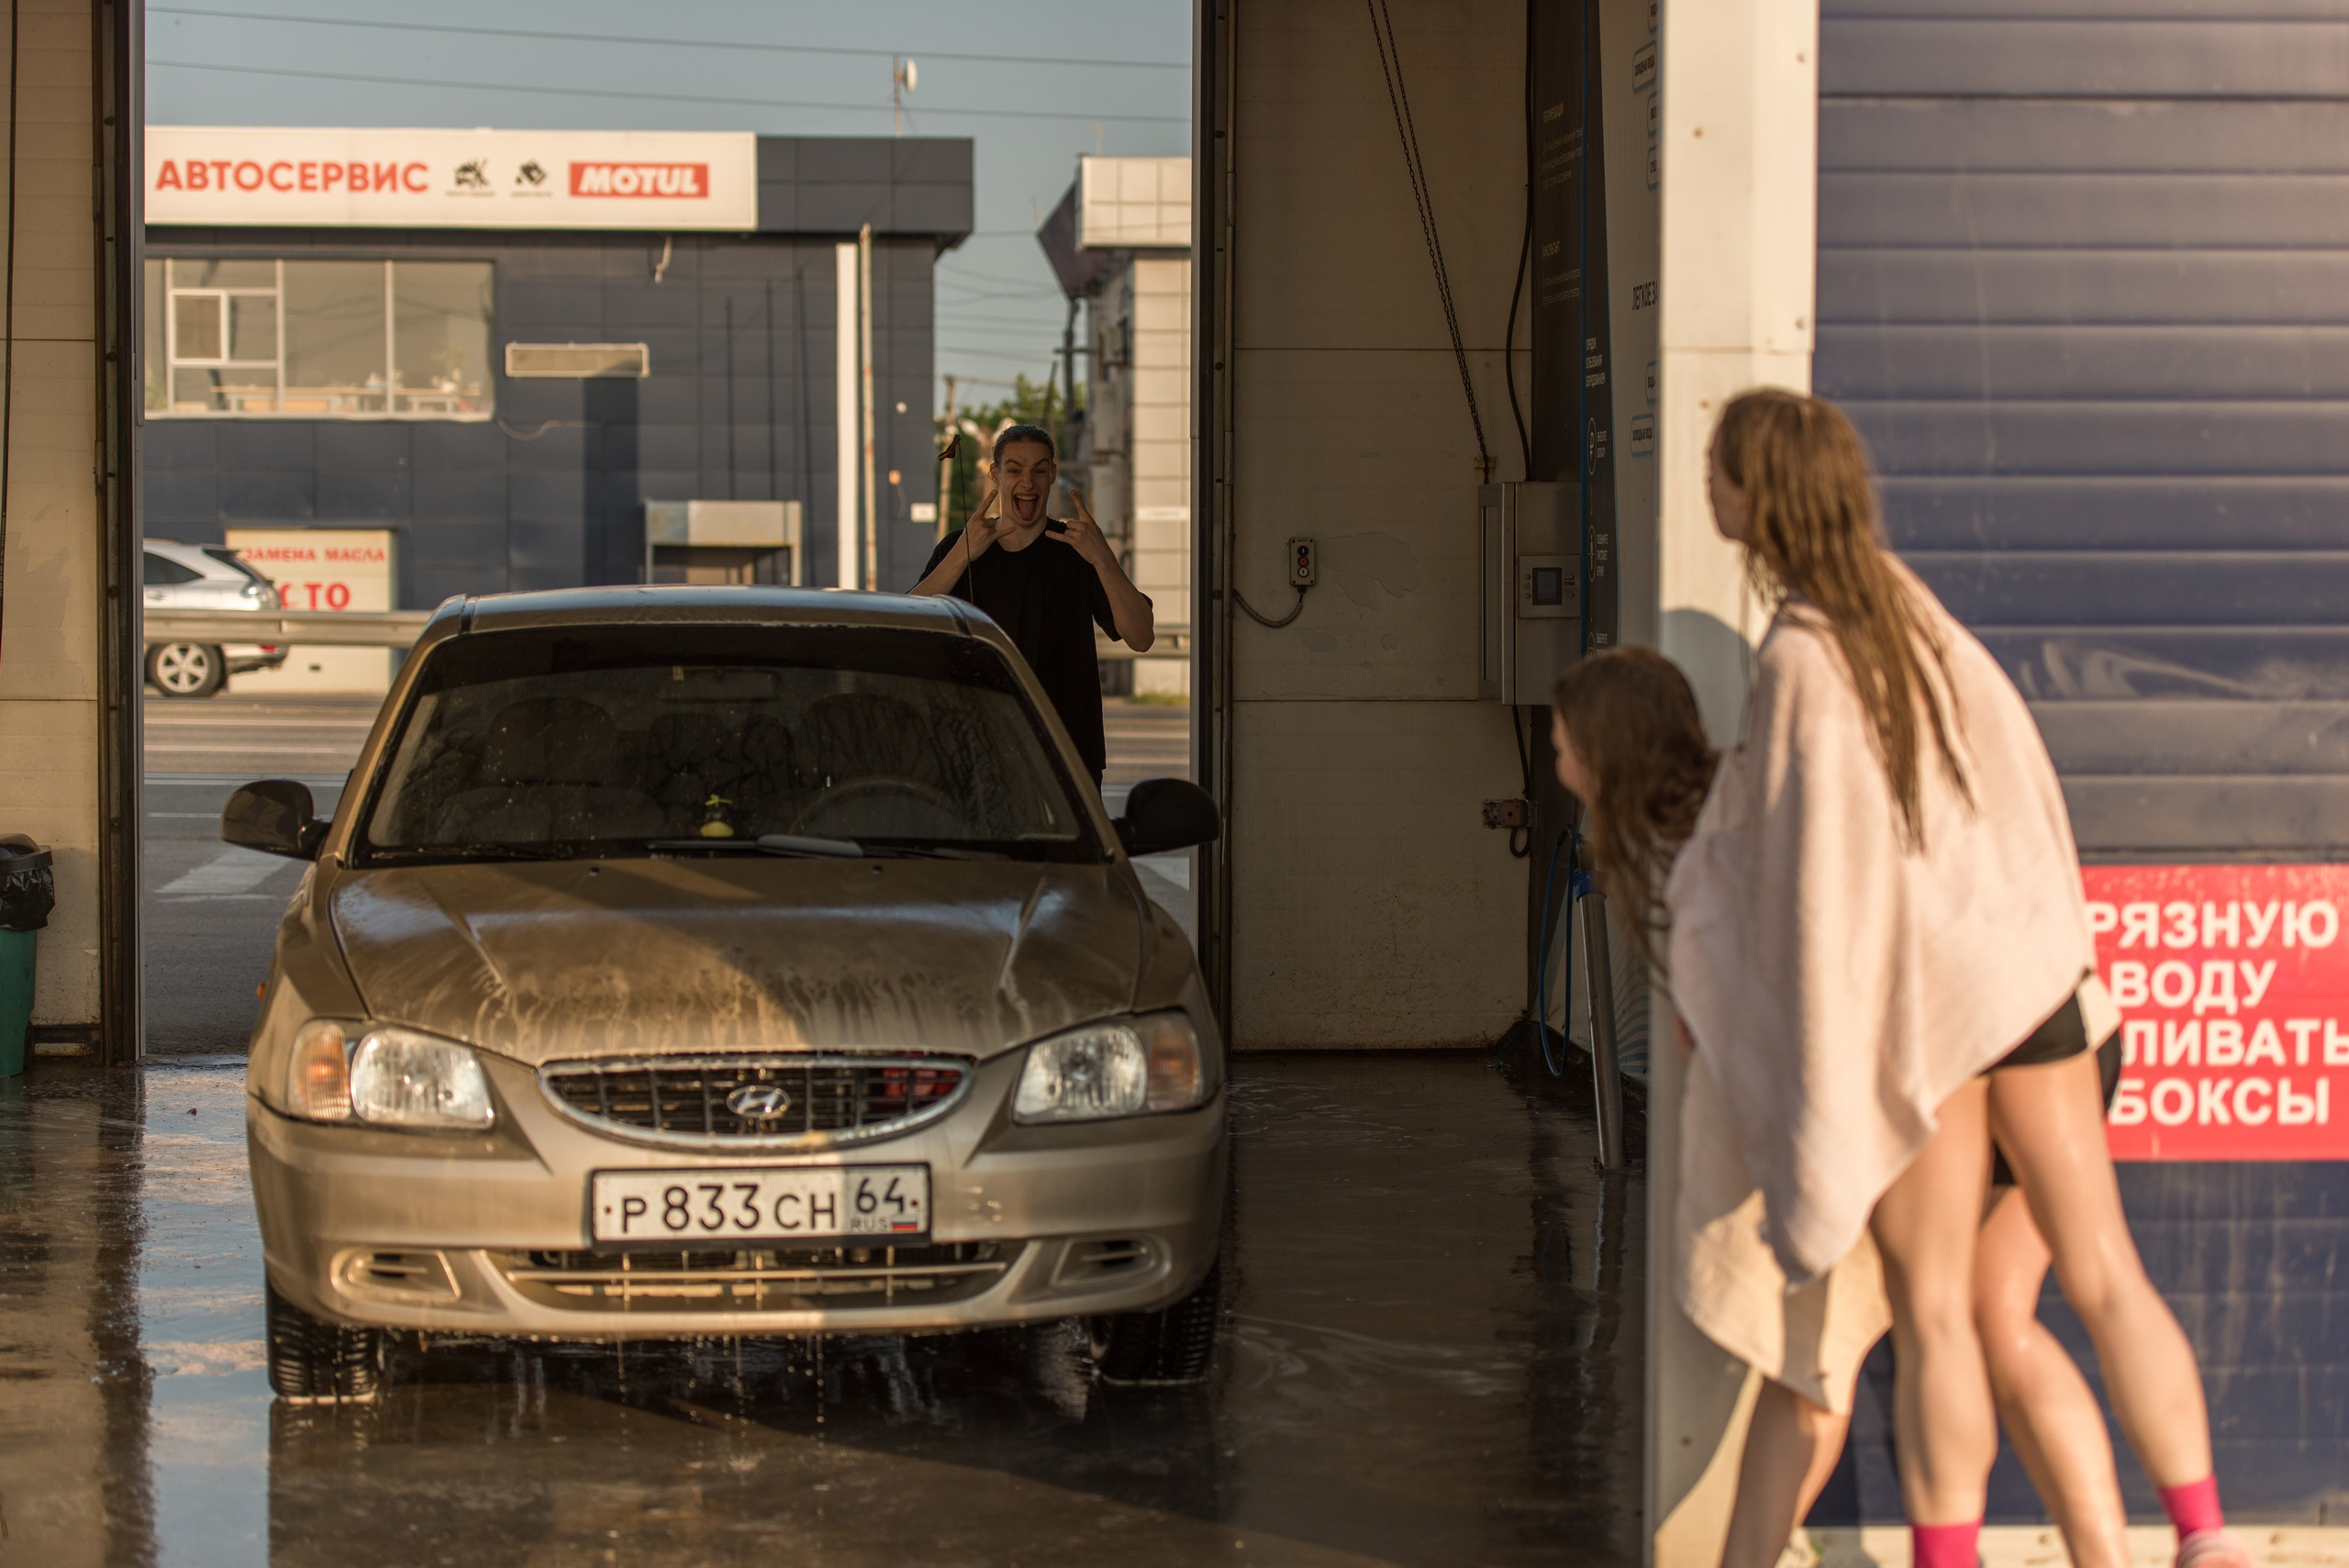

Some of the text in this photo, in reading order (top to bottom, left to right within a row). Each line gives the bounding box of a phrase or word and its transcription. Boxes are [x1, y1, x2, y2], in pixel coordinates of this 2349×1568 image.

[154, 159, 429, 193] АВТОСЕРВИС
[577, 165, 700, 195] MOTUL
[243, 548, 386, 562] ЗАМЕНА МАСЛА
[304, 583, 351, 611] ТО
[2084, 900, 2340, 949] РЯЗНУЮ
[2110, 960, 2277, 1017] ВОДУ
[2121, 1018, 2349, 1067] ЛИВАТЬ
[2108, 1076, 2330, 1126] БОКСЫ
[855, 1176, 905, 1214] 64
[850, 1217, 888, 1232] RUS
